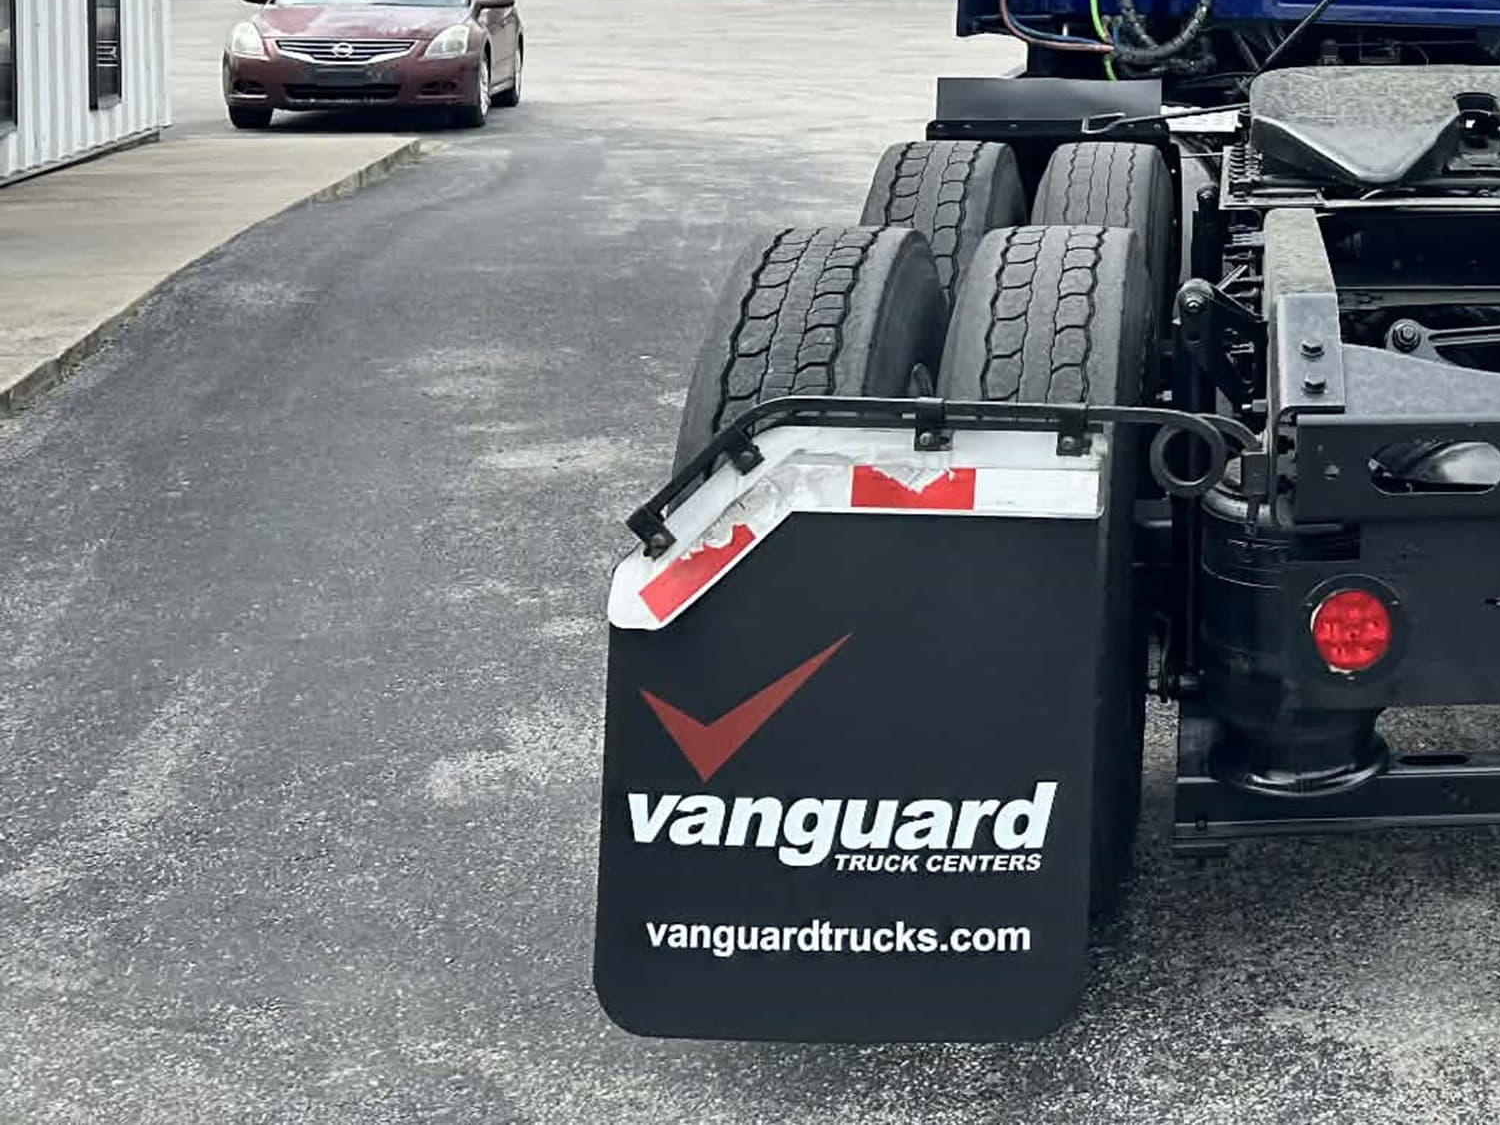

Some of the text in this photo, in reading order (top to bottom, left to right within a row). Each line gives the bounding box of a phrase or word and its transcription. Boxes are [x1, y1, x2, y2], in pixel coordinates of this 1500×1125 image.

[627, 781, 1059, 867] vanguard
[834, 853, 1042, 873] TRUCK CENTERS
[645, 919, 1031, 958] vanguardtrucks.com
